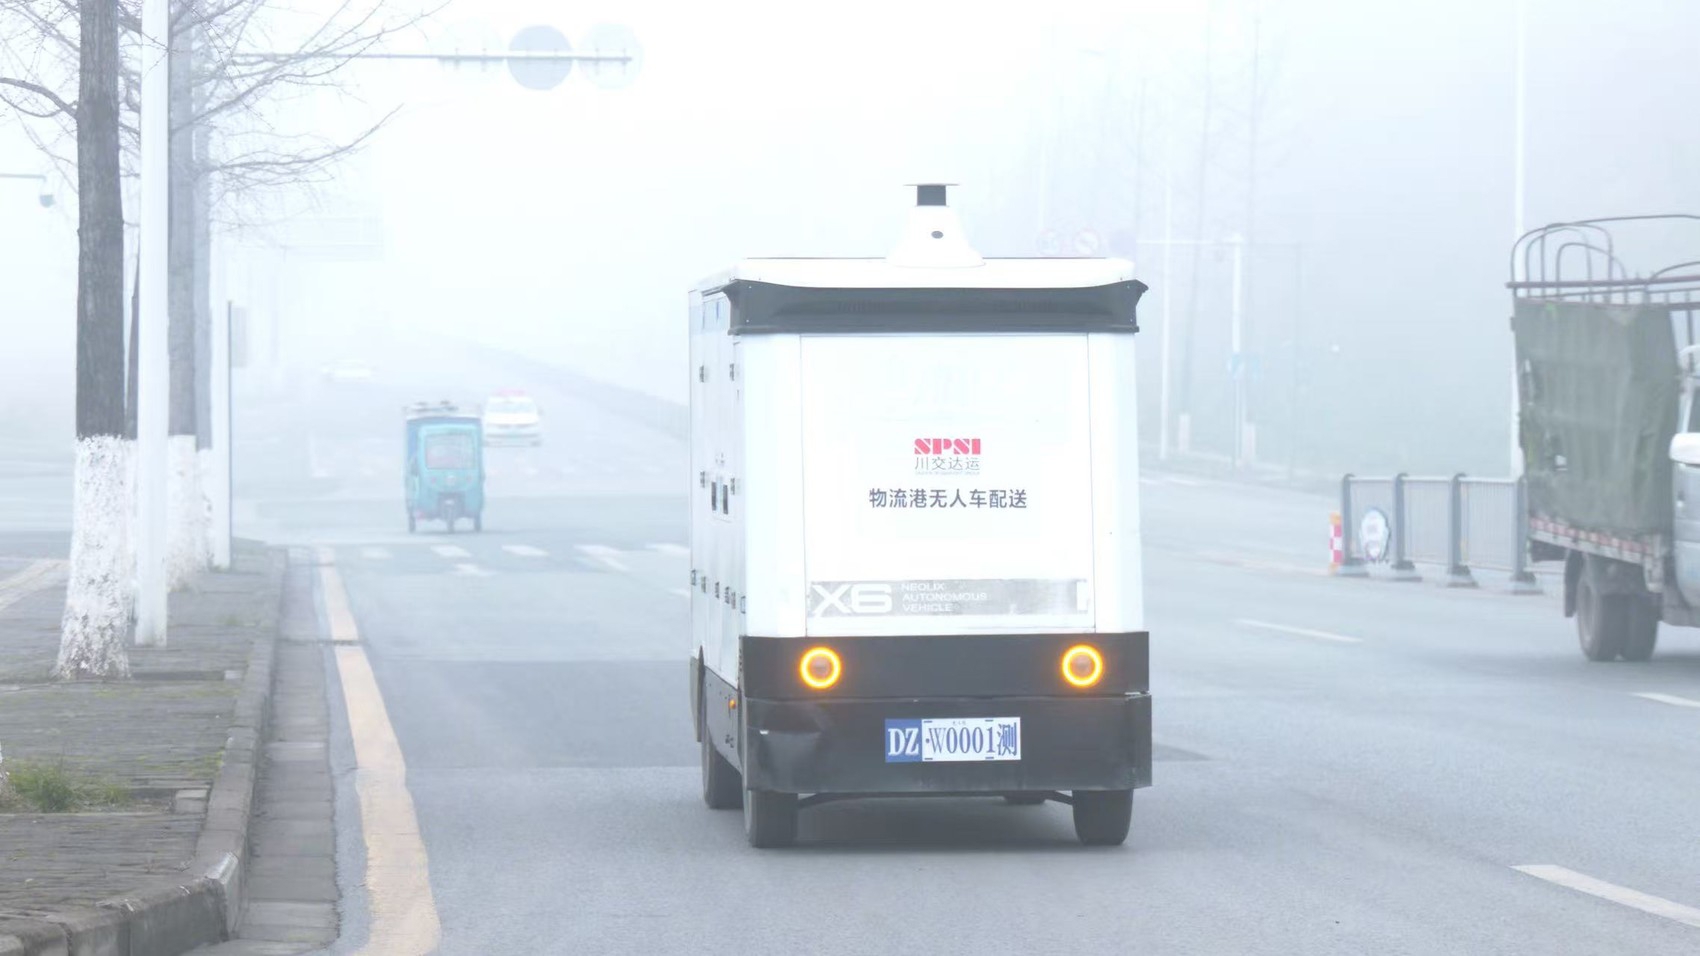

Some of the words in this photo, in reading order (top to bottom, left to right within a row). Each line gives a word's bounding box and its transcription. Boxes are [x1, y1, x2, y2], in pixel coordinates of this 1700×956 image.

[914, 438, 981, 455] SPSI
[914, 456, 981, 471] 川交达运
[869, 488, 1027, 509] 物流港无人车配送
[901, 582, 945, 591] NEOLIX
[812, 583, 893, 617] X6
[902, 592, 988, 602] AUTONOMOUS
[902, 603, 954, 612] VEHICLE
